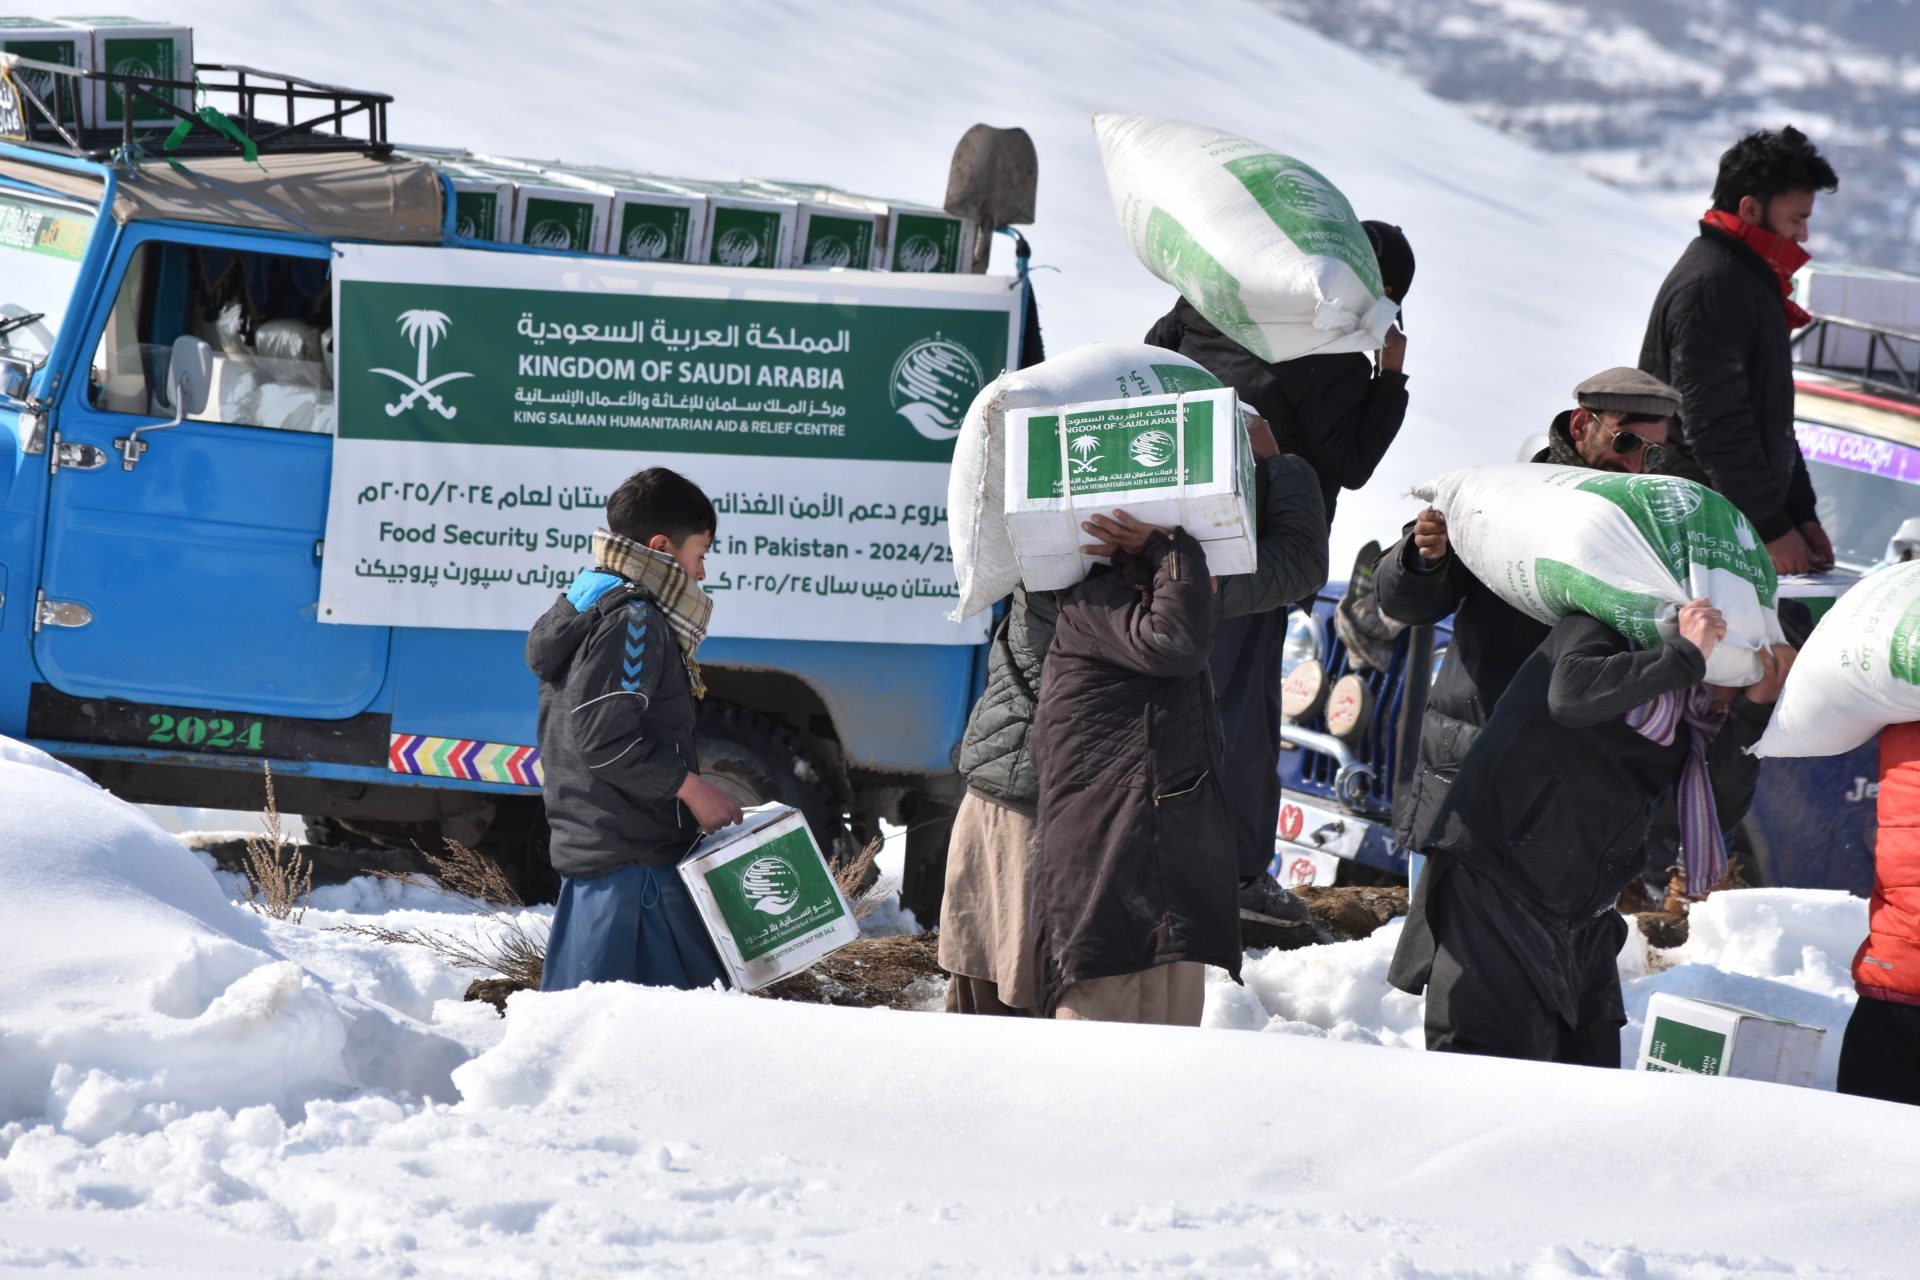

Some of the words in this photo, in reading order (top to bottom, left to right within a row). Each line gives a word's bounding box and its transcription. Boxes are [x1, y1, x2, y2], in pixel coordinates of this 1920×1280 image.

[517, 312, 645, 346] السعودية
[651, 318, 740, 353] العربية
[746, 322, 850, 354] المملكة
[518, 354, 636, 381] KINGDOM
[641, 360, 673, 382] OF
[678, 361, 751, 386] SAUDI
[756, 365, 845, 389] ARABIA
[706, 396, 761, 412] سلمان
[763, 398, 807, 415] الملك
[807, 400, 846, 417] مركز
[514, 411, 546, 424] KING
[549, 412, 607, 427] SALMAN
[610, 415, 713, 431] HUMANITARIAN
[715, 419, 738, 432] AID
[739, 420, 749, 432] &
[751, 420, 793, 434] RELIEF
[794, 423, 845, 436] CENTRE
[1055, 424, 1102, 436] KNGDOM
[1103, 422, 1117, 430] OF
[1118, 419, 1149, 429] SAUDI
[1150, 415, 1188, 425] ARABA
[498, 484, 552, 510] لعام
[558, 486, 608, 510] ستان
[789, 491, 843, 519] الأمن
[848, 503, 897, 523] دعم
[901, 504, 948, 526] روع
[379, 521, 436, 543] Food
[443, 524, 538, 552] Security
[545, 527, 592, 554] Sup
[729, 535, 748, 555] in
[754, 535, 848, 558] Pakistan
[815, 575, 858, 596] سال
[147, 713, 265, 750] 2024
[804, 935, 814, 944] NOT
[814, 931, 824, 940] FOR
[823, 926, 836, 936] SALE
